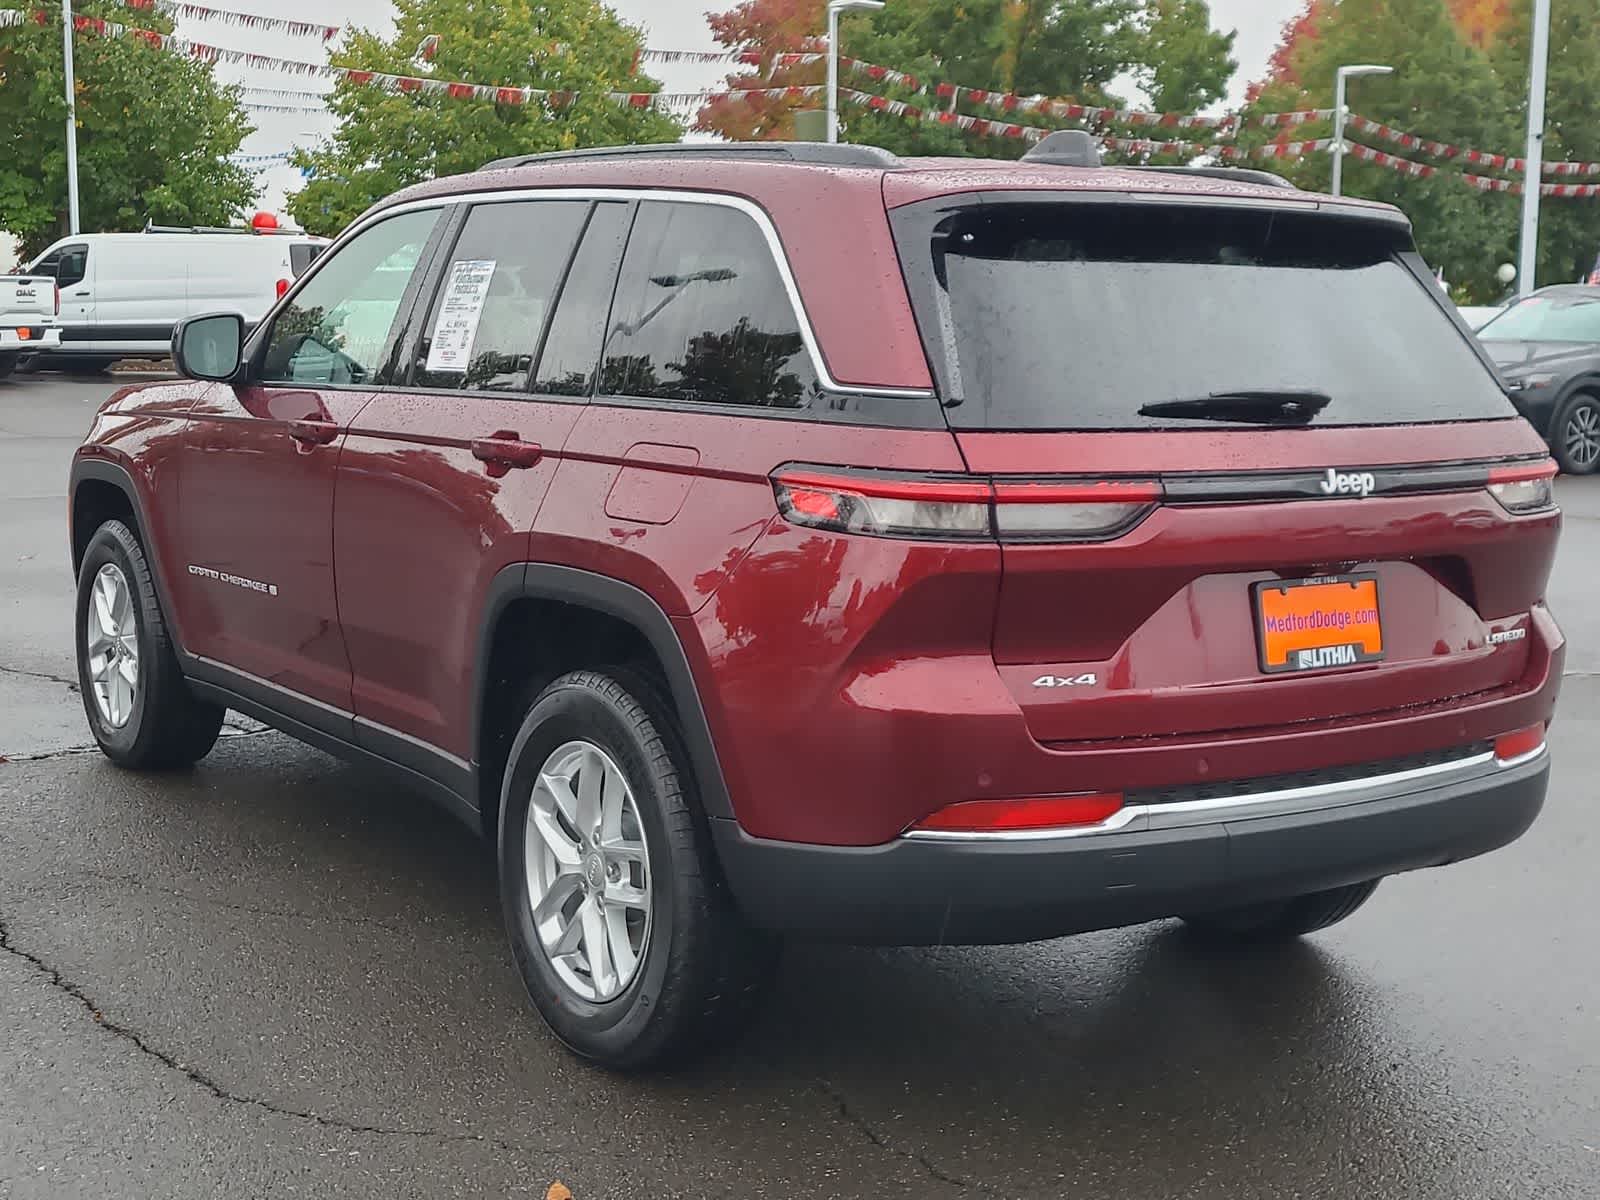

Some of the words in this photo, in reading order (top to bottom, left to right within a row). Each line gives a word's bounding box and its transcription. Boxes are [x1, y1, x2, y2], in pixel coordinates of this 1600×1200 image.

[1320, 468, 1375, 496] Jeep
[188, 565, 220, 579] GRAND
[220, 572, 269, 593] CHEROKEE
[1265, 608, 1378, 632] MedfordDodge.com
[1311, 644, 1356, 669] LITHIA
[1032, 673, 1097, 687] 4x4
